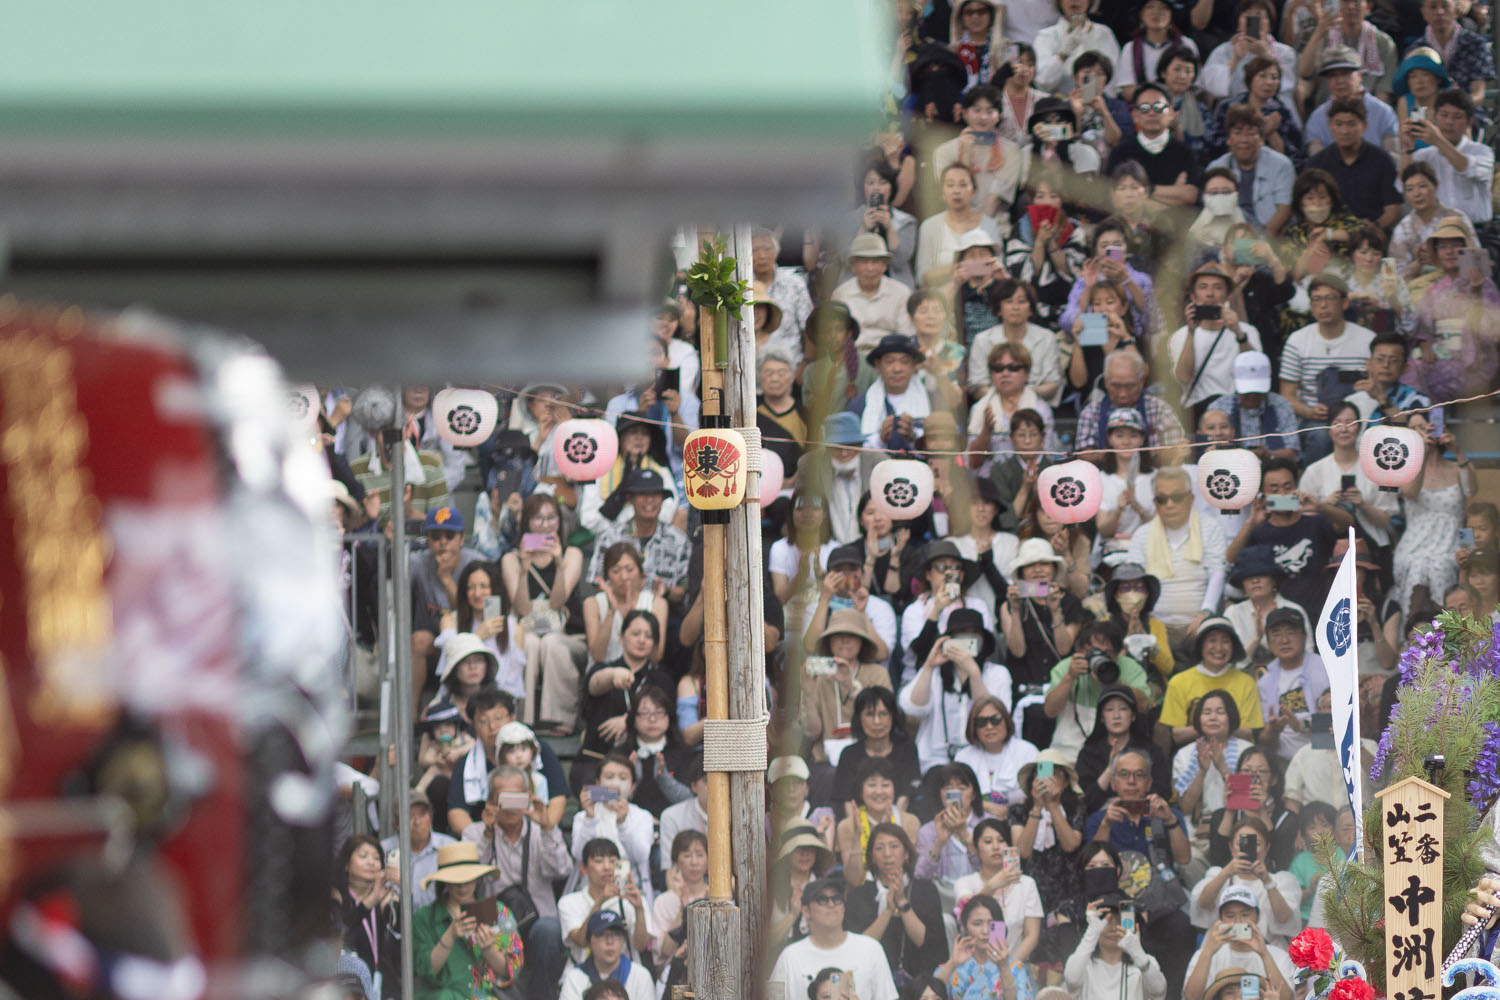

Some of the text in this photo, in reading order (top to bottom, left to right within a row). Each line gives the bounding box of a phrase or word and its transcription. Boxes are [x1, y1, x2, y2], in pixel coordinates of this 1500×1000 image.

[695, 446, 722, 474] 東
[1386, 803, 1414, 865] 山笠
[1414, 803, 1441, 865] 二番
